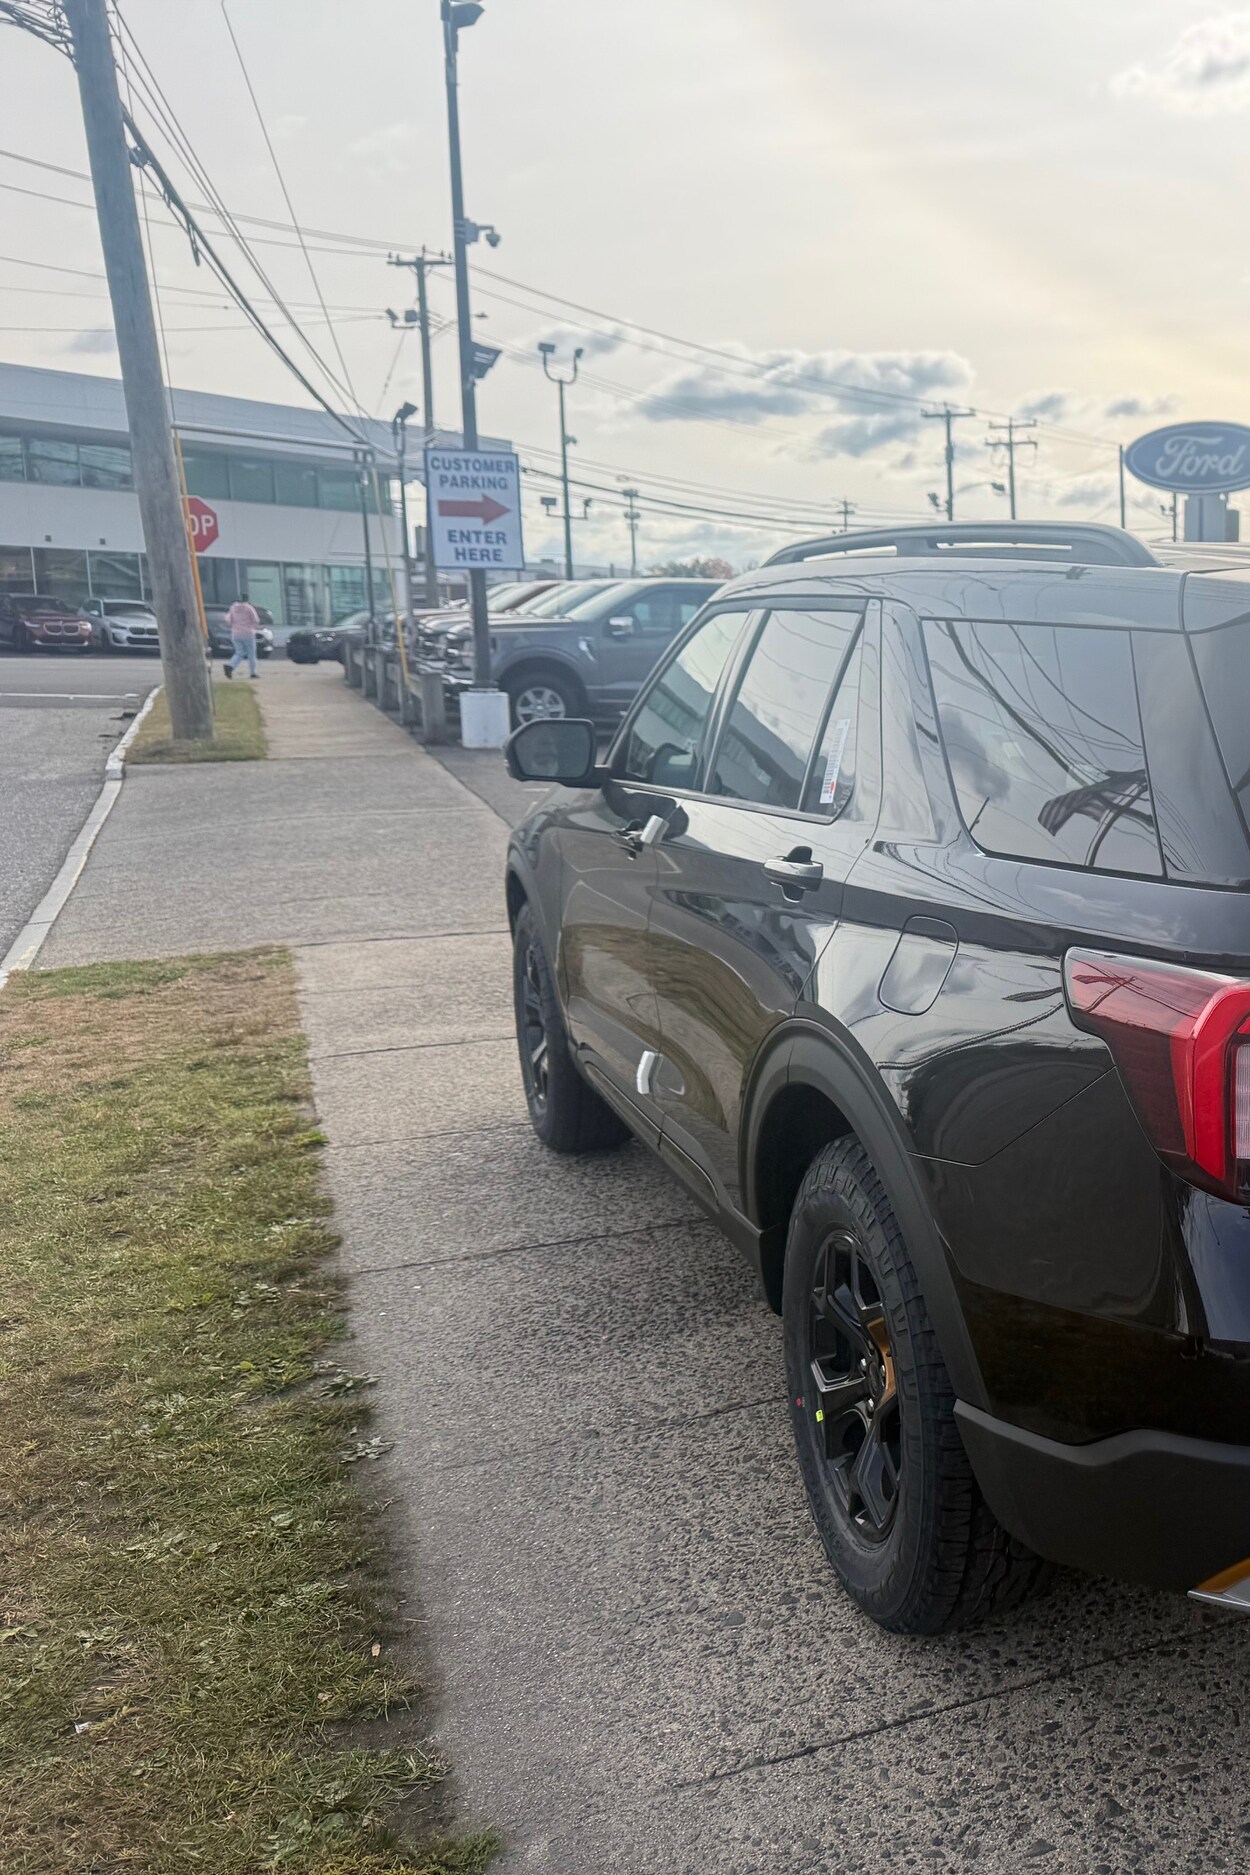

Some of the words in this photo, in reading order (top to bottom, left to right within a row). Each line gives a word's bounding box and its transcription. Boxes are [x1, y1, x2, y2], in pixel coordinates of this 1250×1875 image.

[1155, 435, 1247, 477] Ford
[430, 456, 515, 473] CUSTOMER
[438, 474, 509, 490] PARKING
[187, 513, 215, 537] OP
[447, 529, 507, 545] ENTER
[454, 547, 503, 562] HERE
